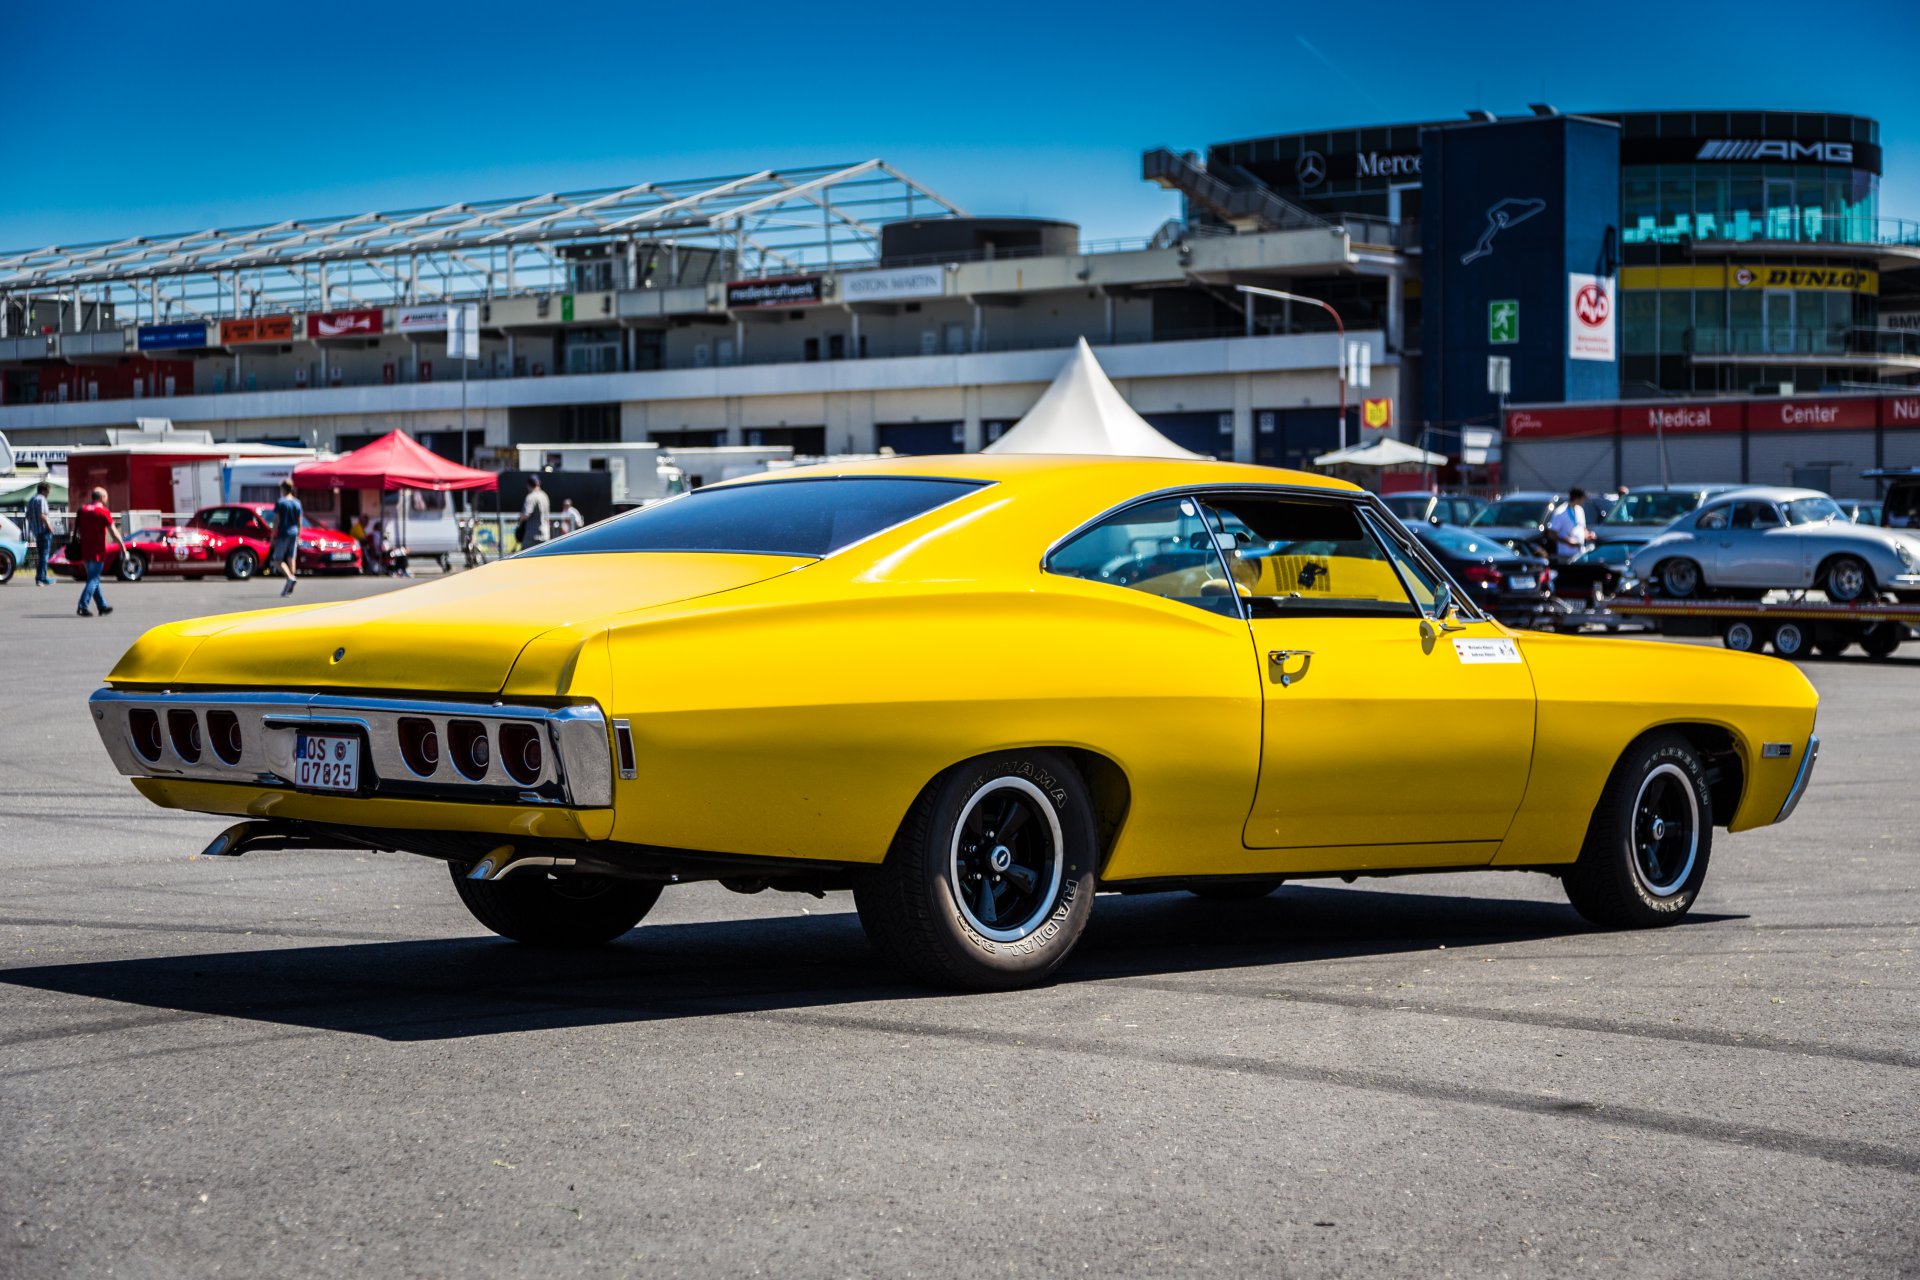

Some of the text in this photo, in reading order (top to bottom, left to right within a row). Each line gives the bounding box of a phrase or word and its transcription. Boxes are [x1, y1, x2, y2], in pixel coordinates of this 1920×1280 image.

[1751, 140, 1853, 163] AMG
[1768, 269, 1867, 288] DUNLOP
[1649, 407, 1711, 428] Medical
[1781, 404, 1838, 424] Center
[307, 738, 326, 761] OS
[301, 761, 352, 787] 07825
[1002, 879, 1079, 957] RADIAL
